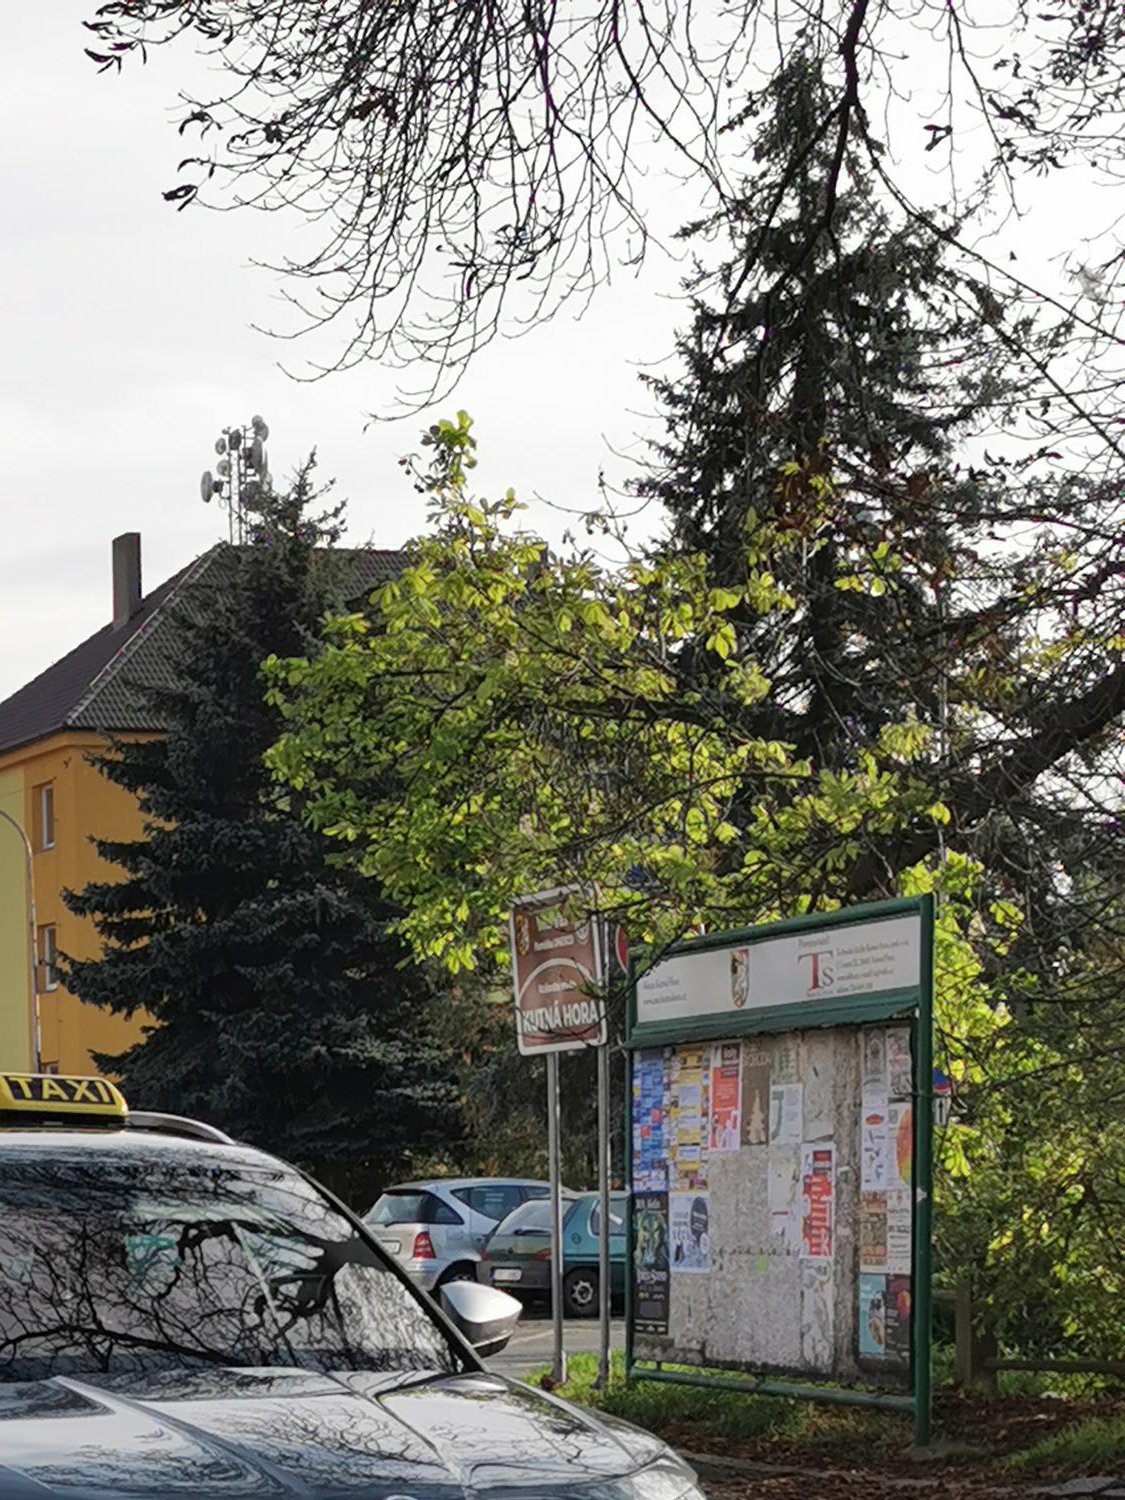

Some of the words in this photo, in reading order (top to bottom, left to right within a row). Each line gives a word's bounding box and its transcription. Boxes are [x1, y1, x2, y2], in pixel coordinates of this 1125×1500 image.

[522, 1001, 562, 1032] KUTNÁ
[562, 1001, 599, 1027] HORA
[9, 1077, 111, 1102] TAXI
